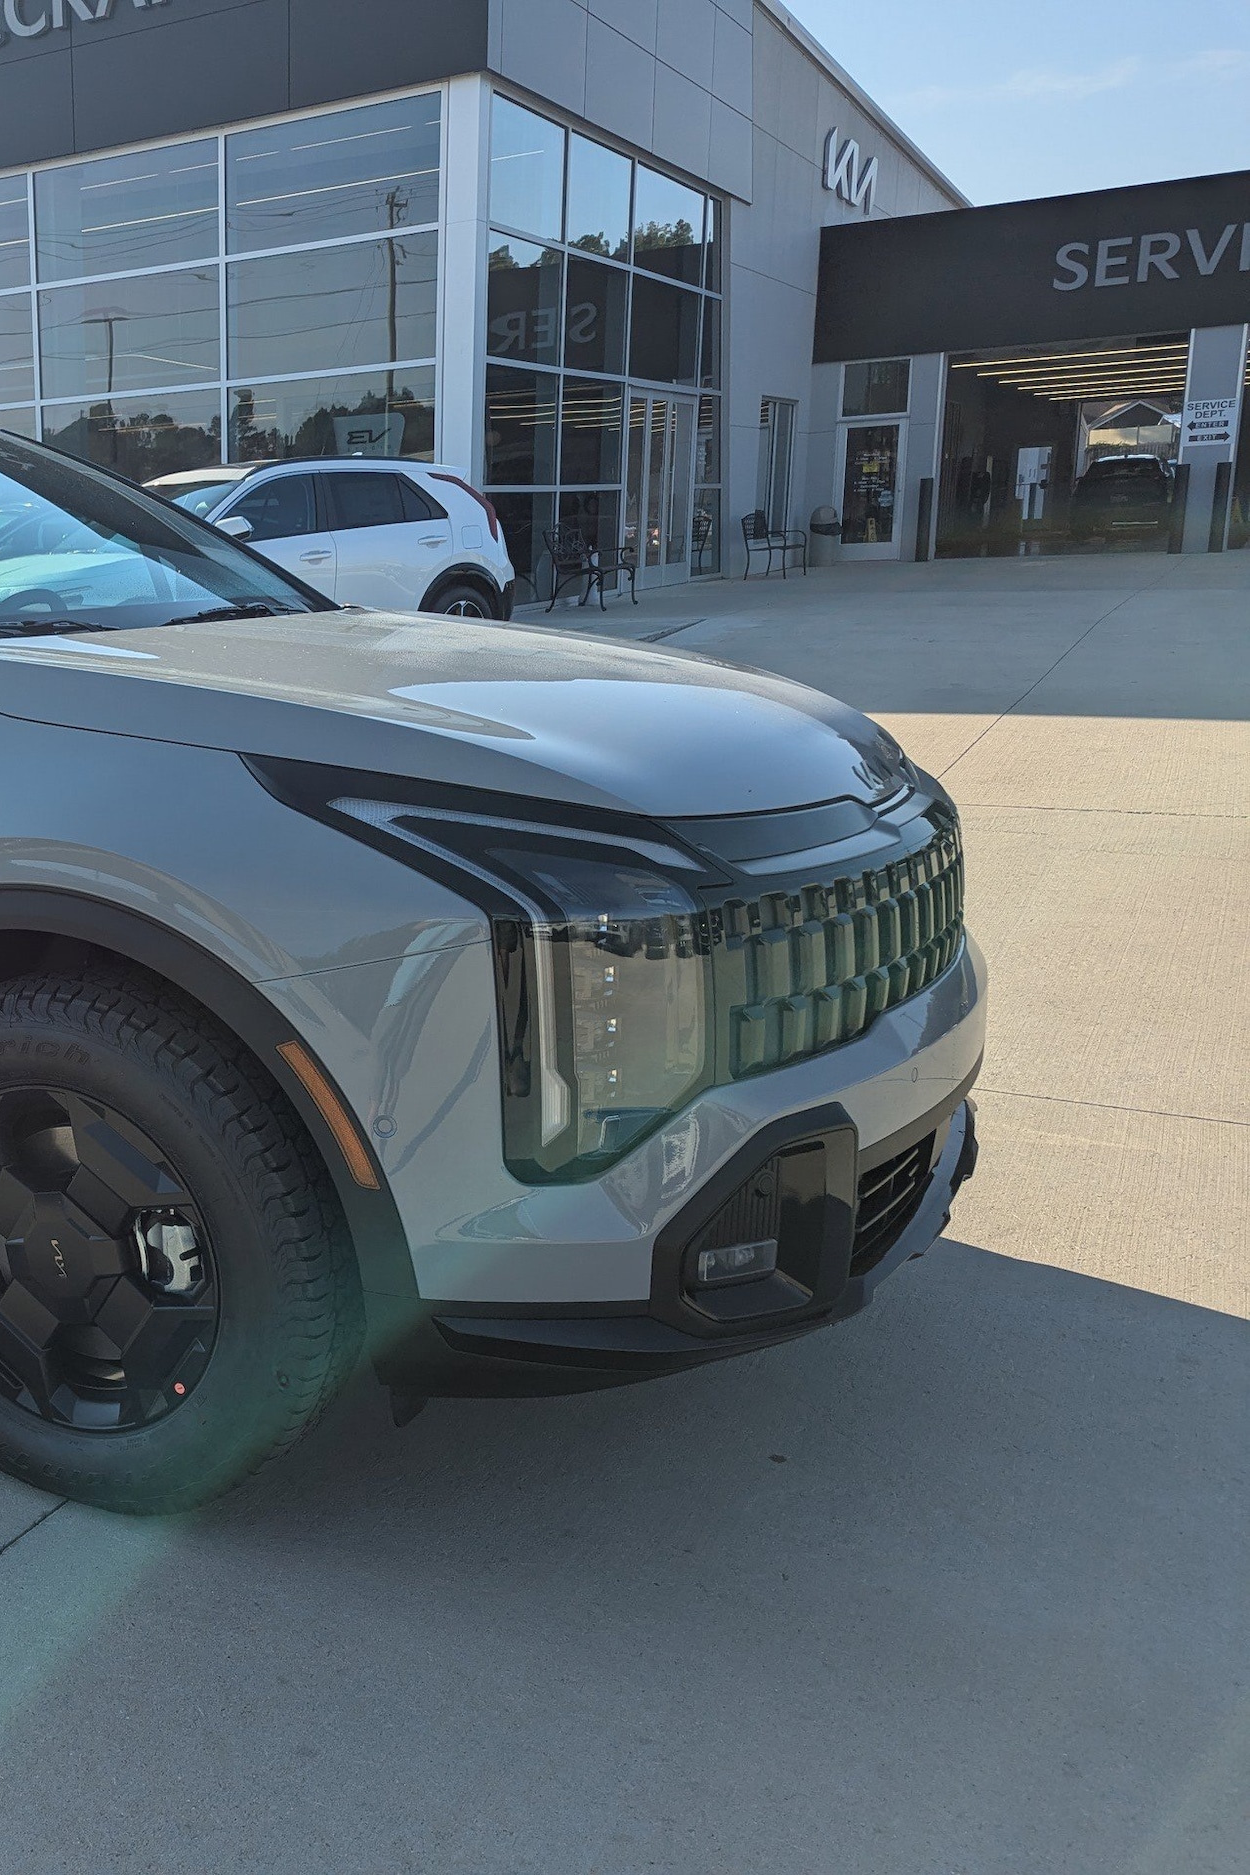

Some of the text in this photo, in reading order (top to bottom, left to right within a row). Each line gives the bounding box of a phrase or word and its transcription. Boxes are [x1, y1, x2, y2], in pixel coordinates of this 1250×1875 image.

[825, 126, 878, 215] KIA
[1187, 400, 1236, 411] SERVICE
[1195, 410, 1226, 418] DEPT.
